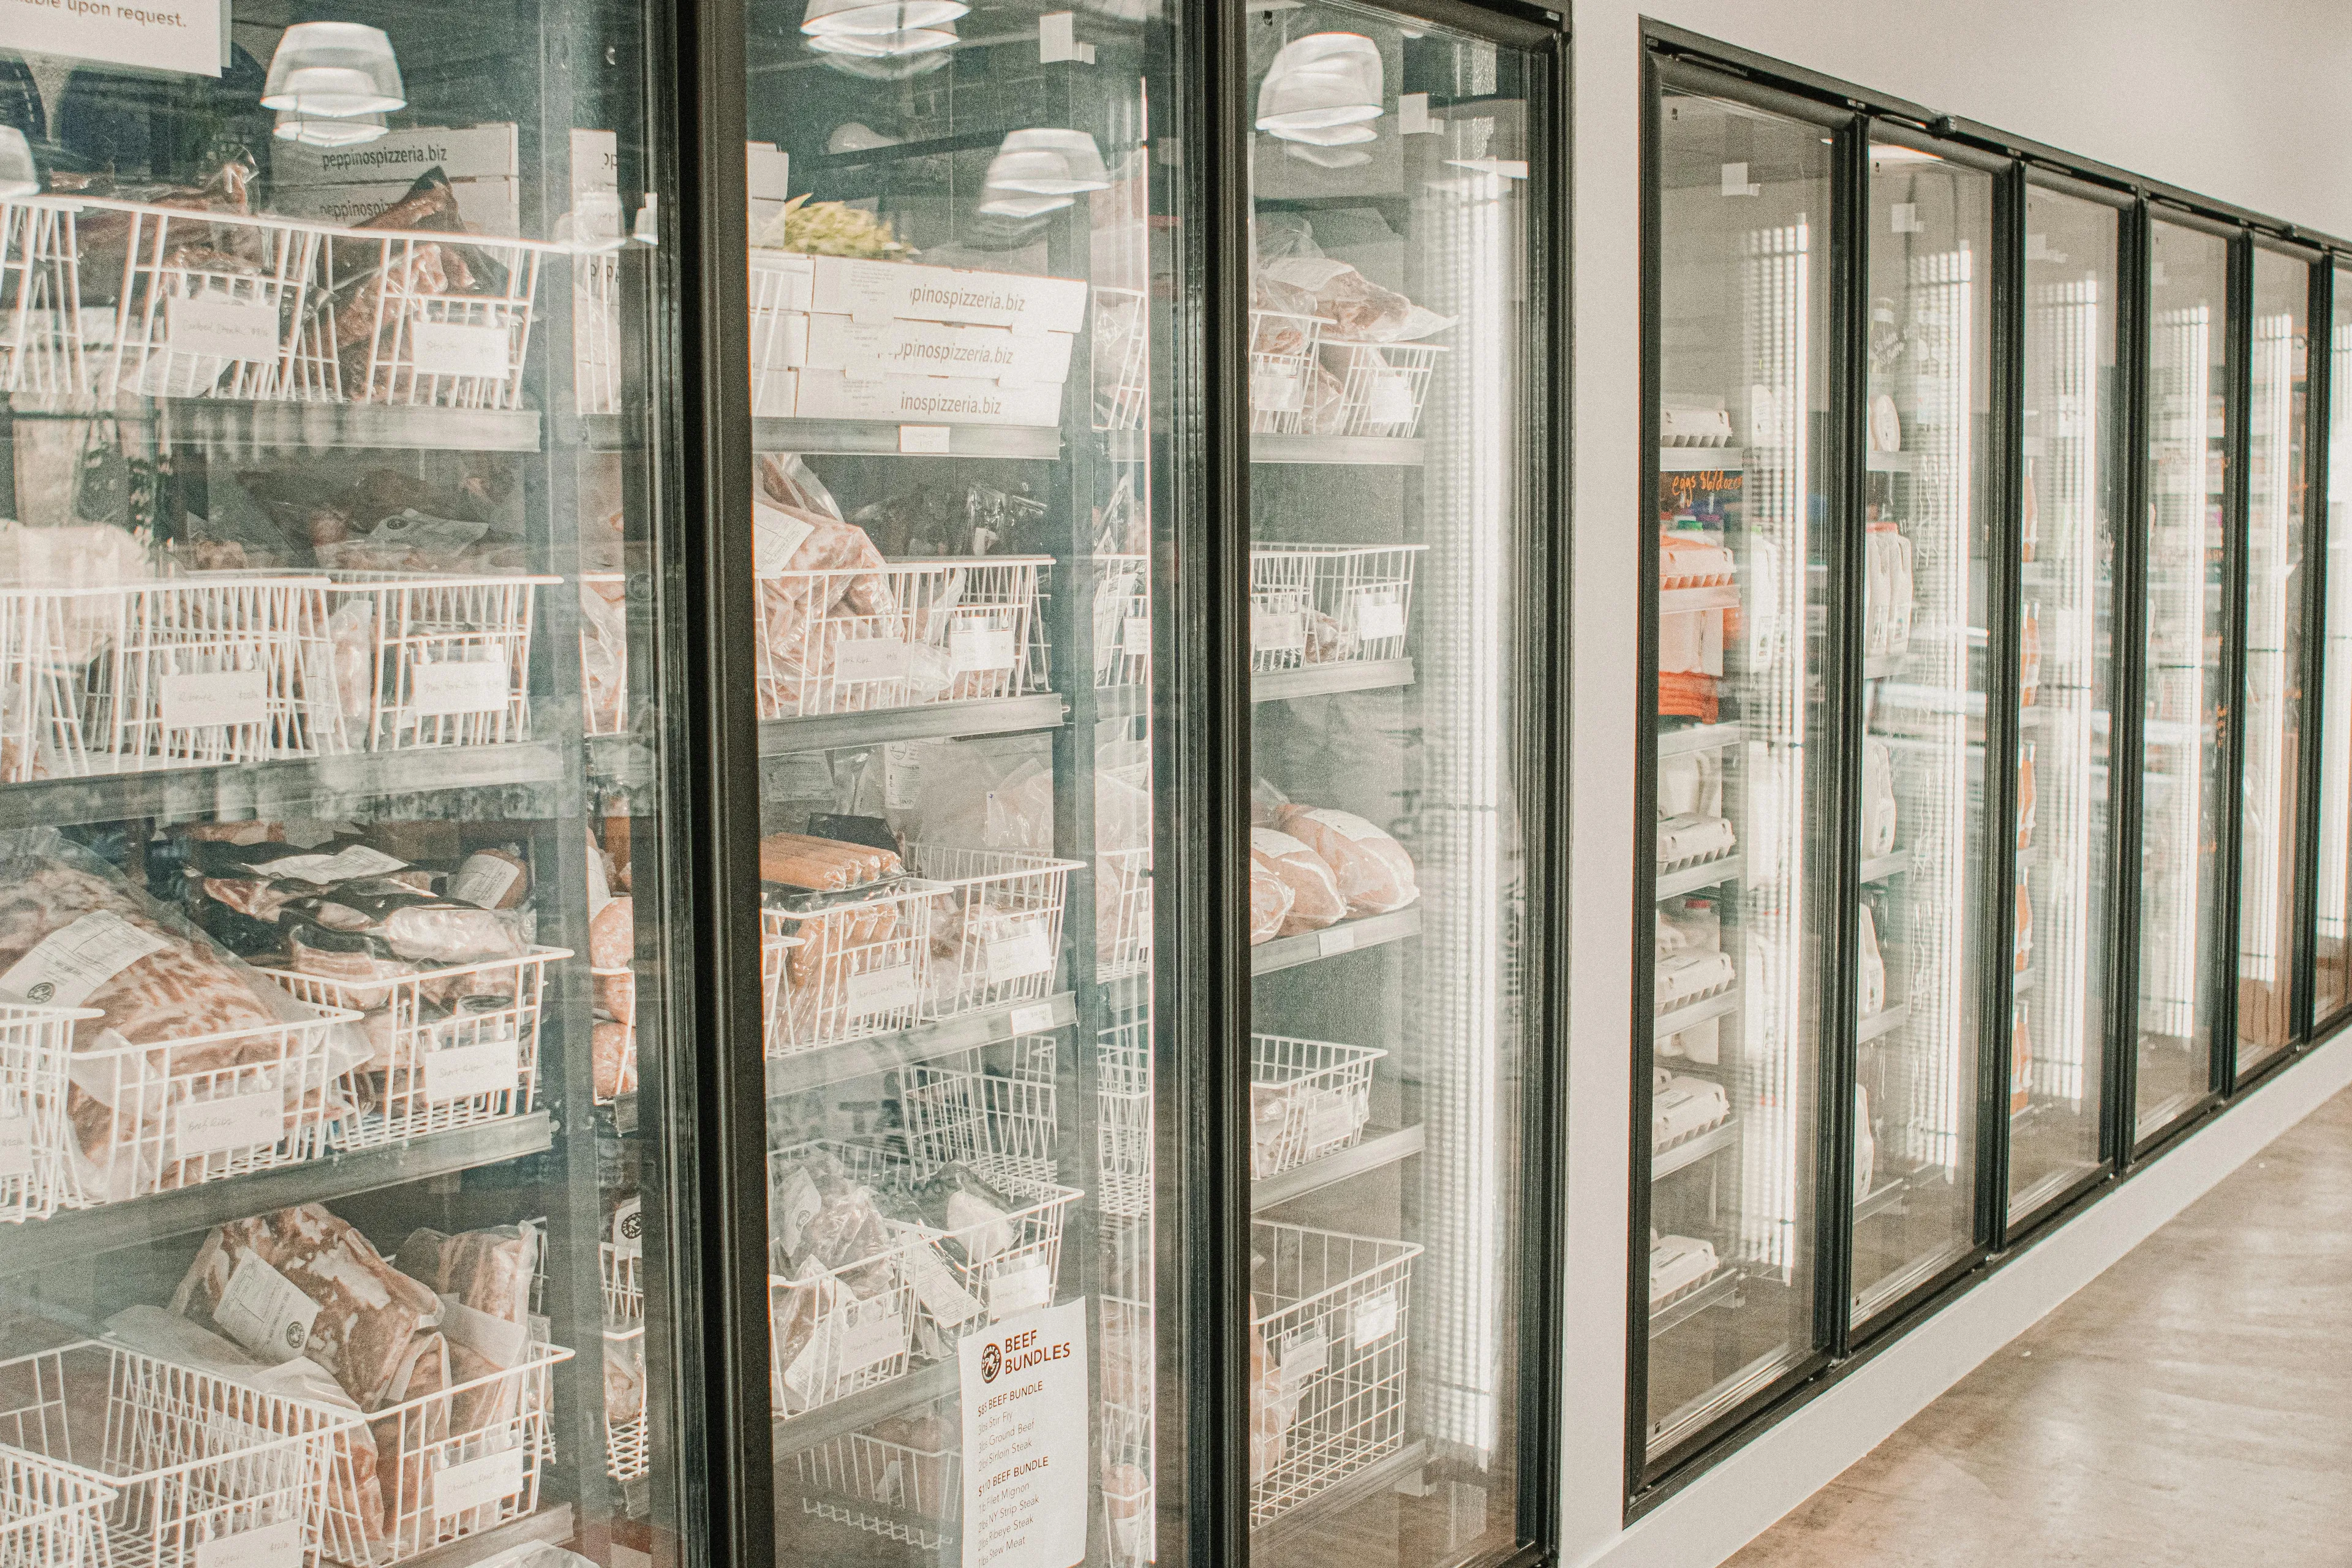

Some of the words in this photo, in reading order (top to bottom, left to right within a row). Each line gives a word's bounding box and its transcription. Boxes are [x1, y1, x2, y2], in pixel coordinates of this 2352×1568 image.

[67, 0, 111, 17] upon
[117, 6, 187, 27] request.
[322, 144, 447, 172] peppinospizzeria.biz
[910, 284, 1026, 312] pinospizzeria.biz
[1671, 475, 1696, 508] eggs
[1005, 1329, 1037, 1354] BEEF
[1005, 1341, 1071, 1375] BUNDLES
[978, 1399, 987, 1417] $85
[989, 1393, 1008, 1410] BEEF
[1010, 1380, 1043, 1401] BUNDLE
[989, 1415, 1000, 1428] Stir
[1003, 1411, 1013, 1423] Fry
[989, 1425, 1015, 1446] Ground
[1018, 1417, 1035, 1434] Beef
[989, 1448, 1009, 1464] Sirloin
[1012, 1438, 1033, 1454] Steak
[978, 1479, 991, 1498] $110
[993, 1469, 1011, 1487] BEEF
[1014, 1456, 1049, 1478] BUNDLE
[987, 1494, 1000, 1506] Filet
[1001, 1482, 1030, 1501] Mignon
[989, 1510, 999, 1523] NY
[1000, 1504, 1017, 1519] Strip
[1020, 1493, 1040, 1511] Steak
[989, 1525, 1011, 1541] Ribeye
[1014, 1513, 1035, 1531] Steak
[989, 1546, 1005, 1561] Stew
[1006, 1536, 1026, 1551] Meat
